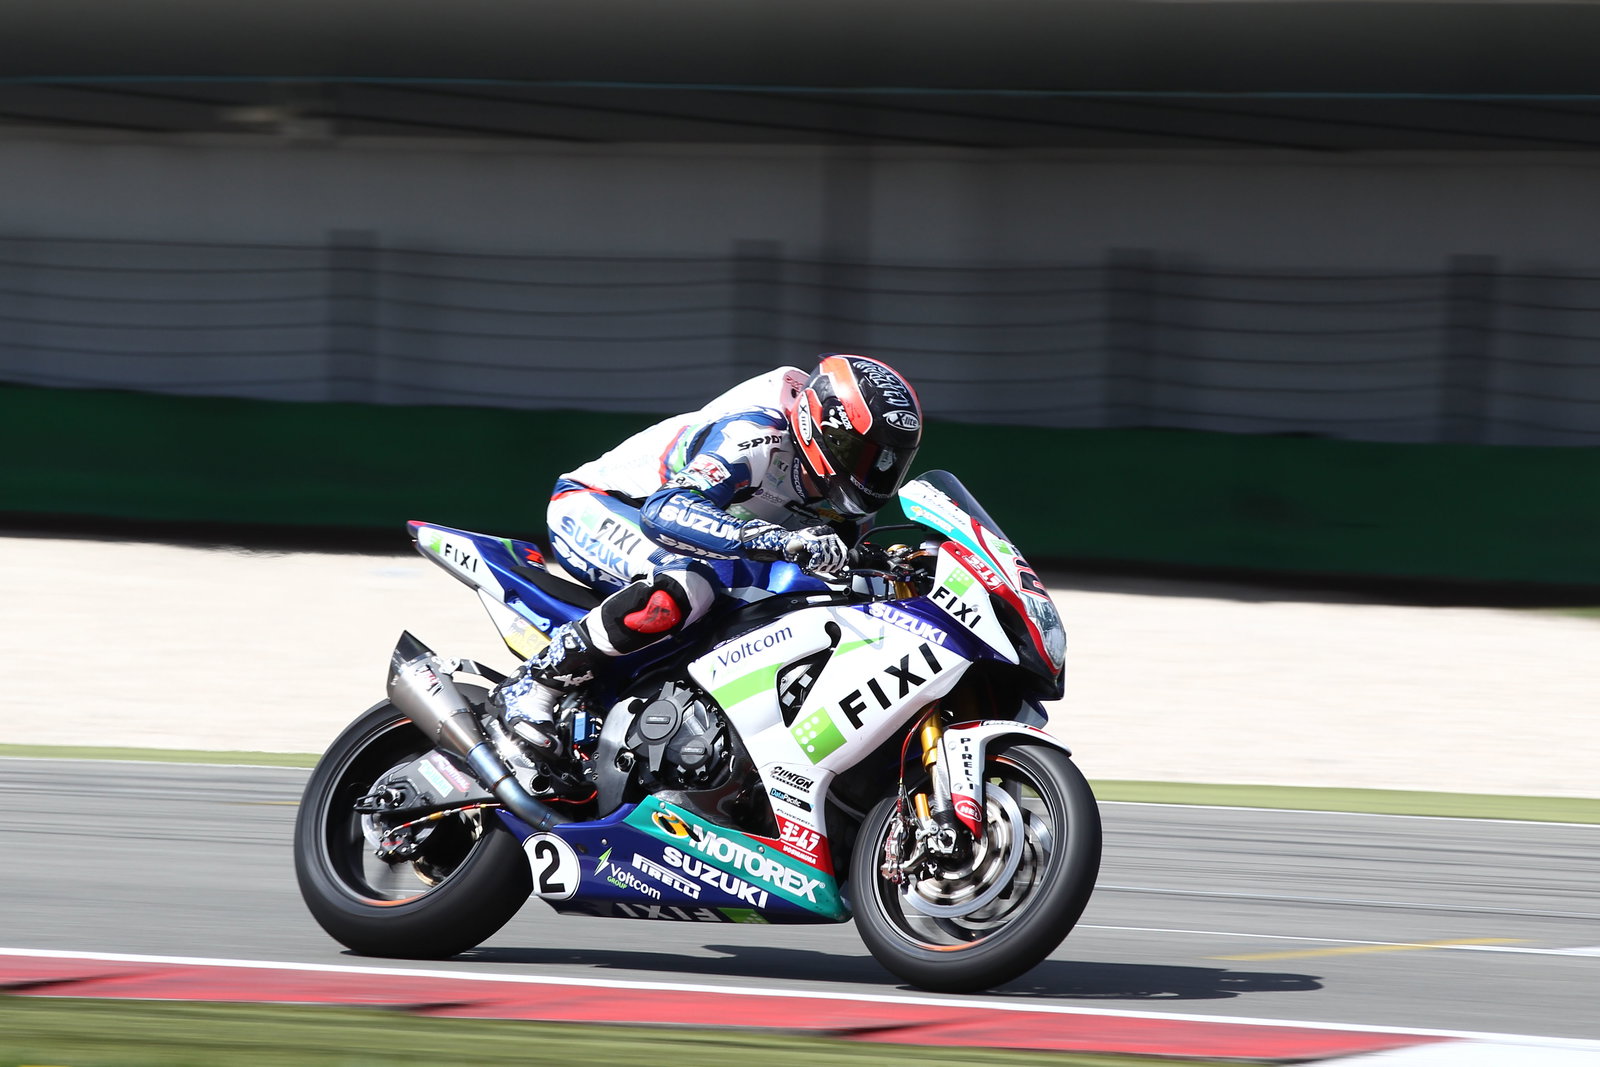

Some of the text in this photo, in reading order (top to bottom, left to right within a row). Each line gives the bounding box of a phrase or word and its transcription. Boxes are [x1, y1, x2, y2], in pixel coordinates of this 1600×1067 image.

[890, 412, 919, 428] X-lite
[598, 517, 642, 556] FIXI
[659, 509, 740, 541] SUZUK
[444, 543, 478, 573] FIXI
[560, 515, 631, 577] SUZUKI
[656, 533, 741, 561] SPIDI
[868, 602, 948, 646] SUZUKI
[932, 586, 982, 629] FIXI
[717, 626, 793, 667] Voltcom
[838, 642, 943, 730] FIXI
[535, 840, 566, 893] 2
[607, 875, 628, 889] GROUP
[611, 863, 661, 900] Voltcom
[632, 852, 703, 900] PIRELLI
[662, 845, 769, 909] SUZUKI
